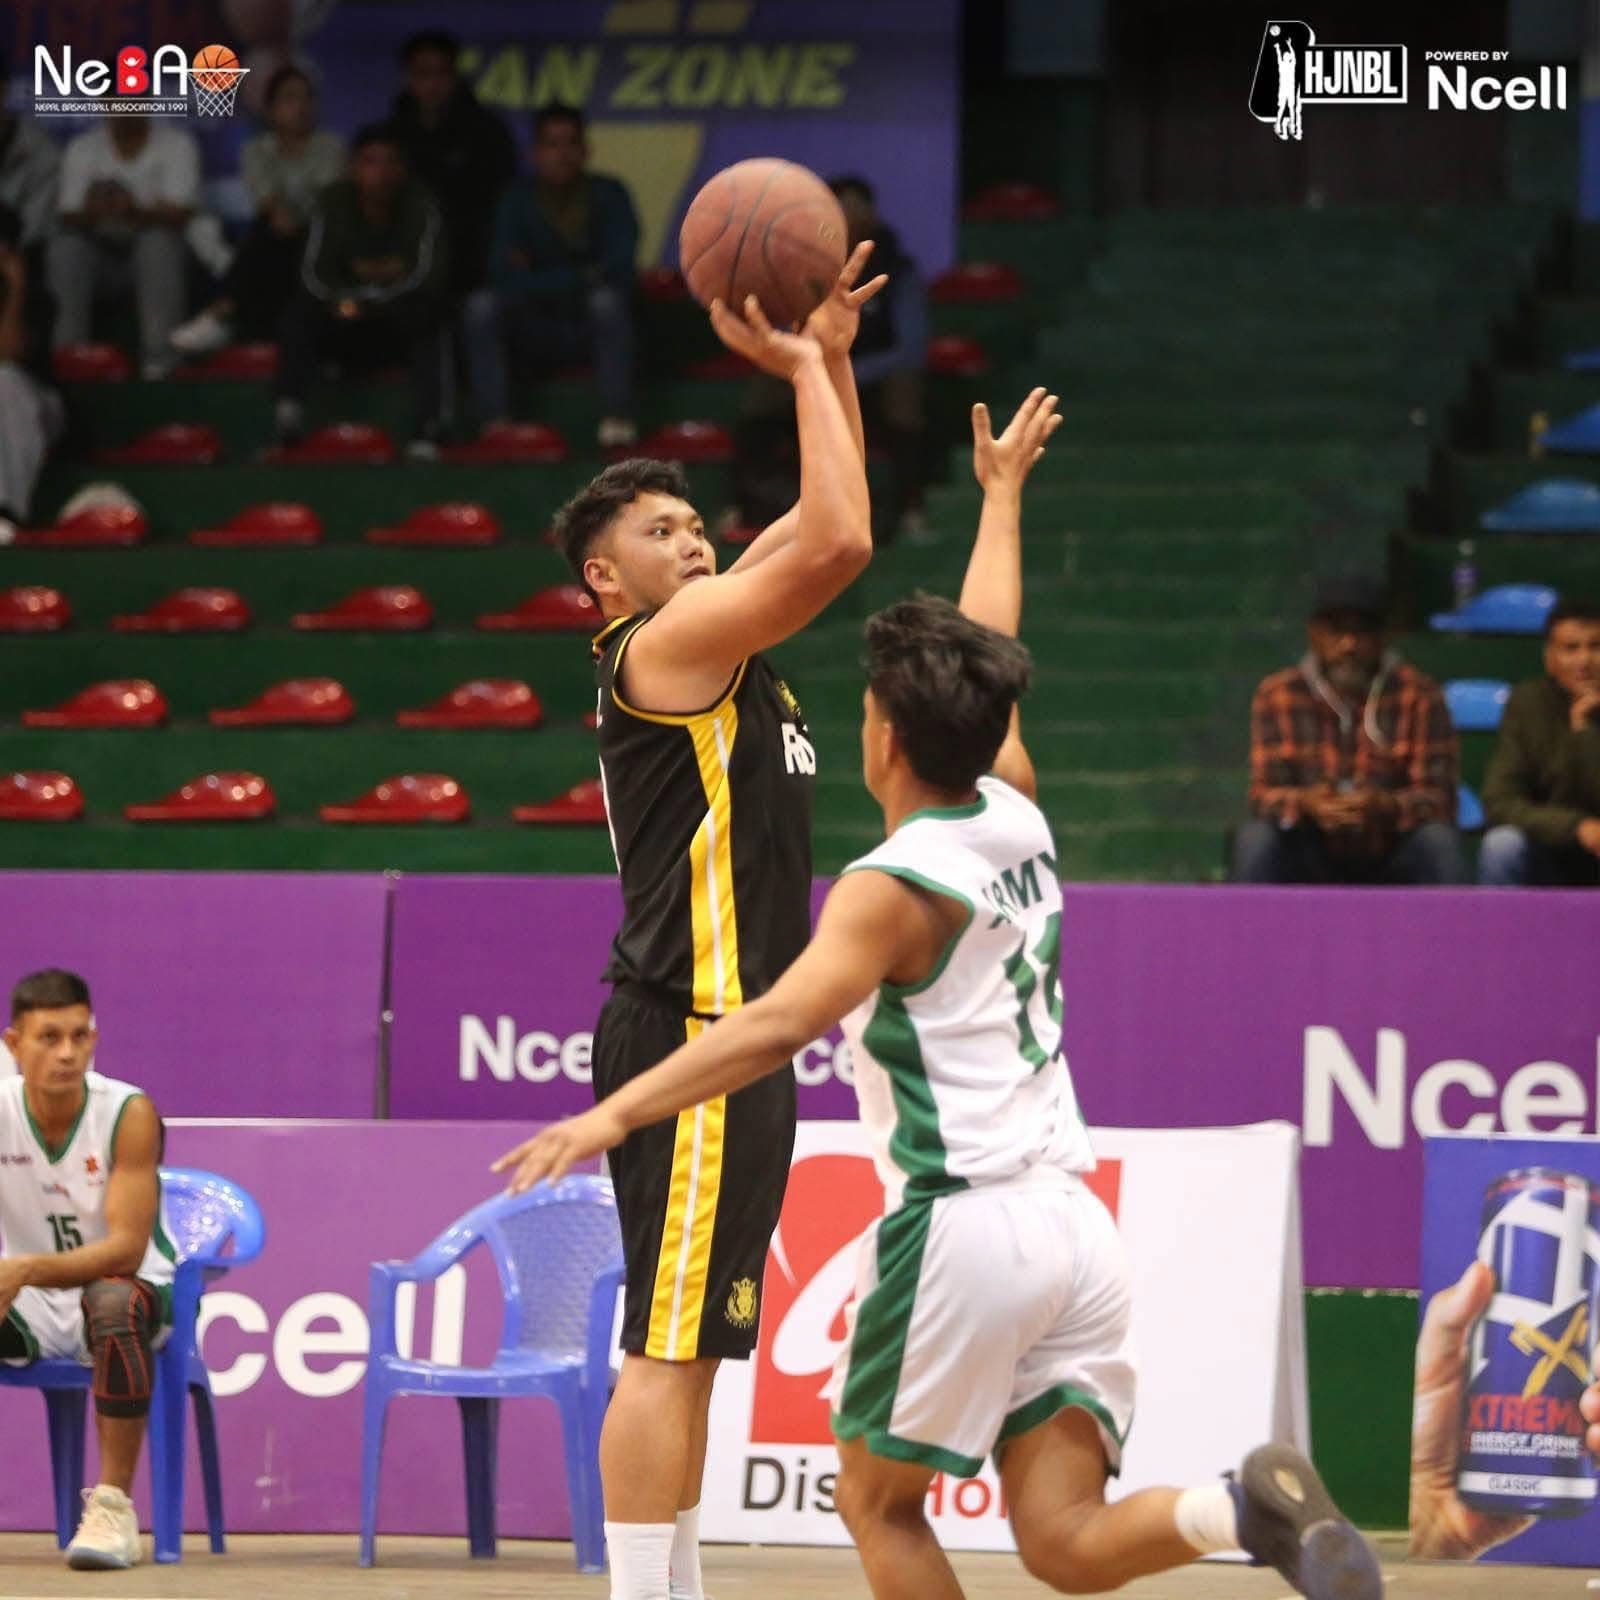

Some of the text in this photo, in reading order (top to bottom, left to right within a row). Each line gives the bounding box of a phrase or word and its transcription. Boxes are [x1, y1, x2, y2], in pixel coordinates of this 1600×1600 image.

[458, 43, 857, 108] AN ZONE
[459, 1014, 593, 1083] Nce
[1303, 1025, 1600, 1149] Nce
[46, 1214, 83, 1252] 15
[196, 1264, 466, 1397] cell
[744, 1457, 838, 1512] Dis
